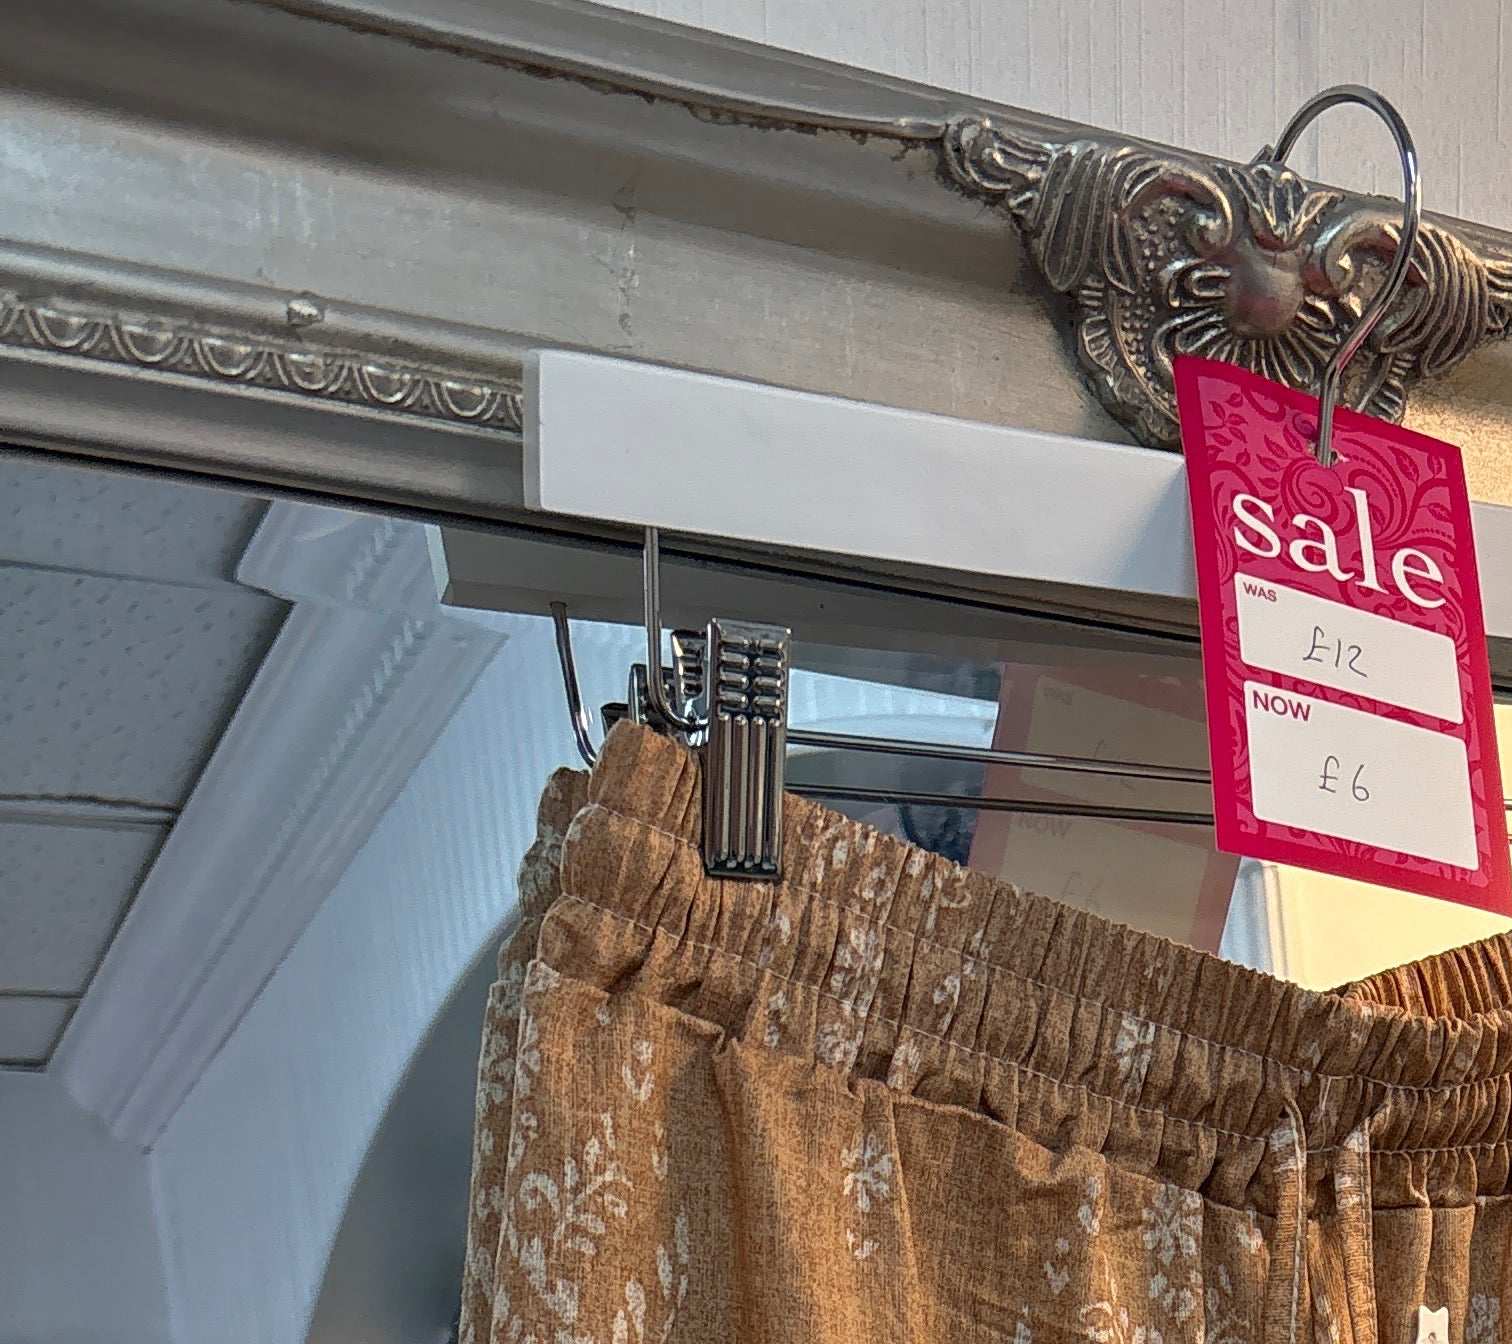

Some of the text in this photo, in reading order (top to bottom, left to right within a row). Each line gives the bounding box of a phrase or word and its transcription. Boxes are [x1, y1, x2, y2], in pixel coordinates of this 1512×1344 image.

[1232, 486, 1447, 609] sale
[1243, 582, 1277, 602] WAS
[1303, 626, 1367, 678] £12
[1253, 690, 1311, 722] NOW
